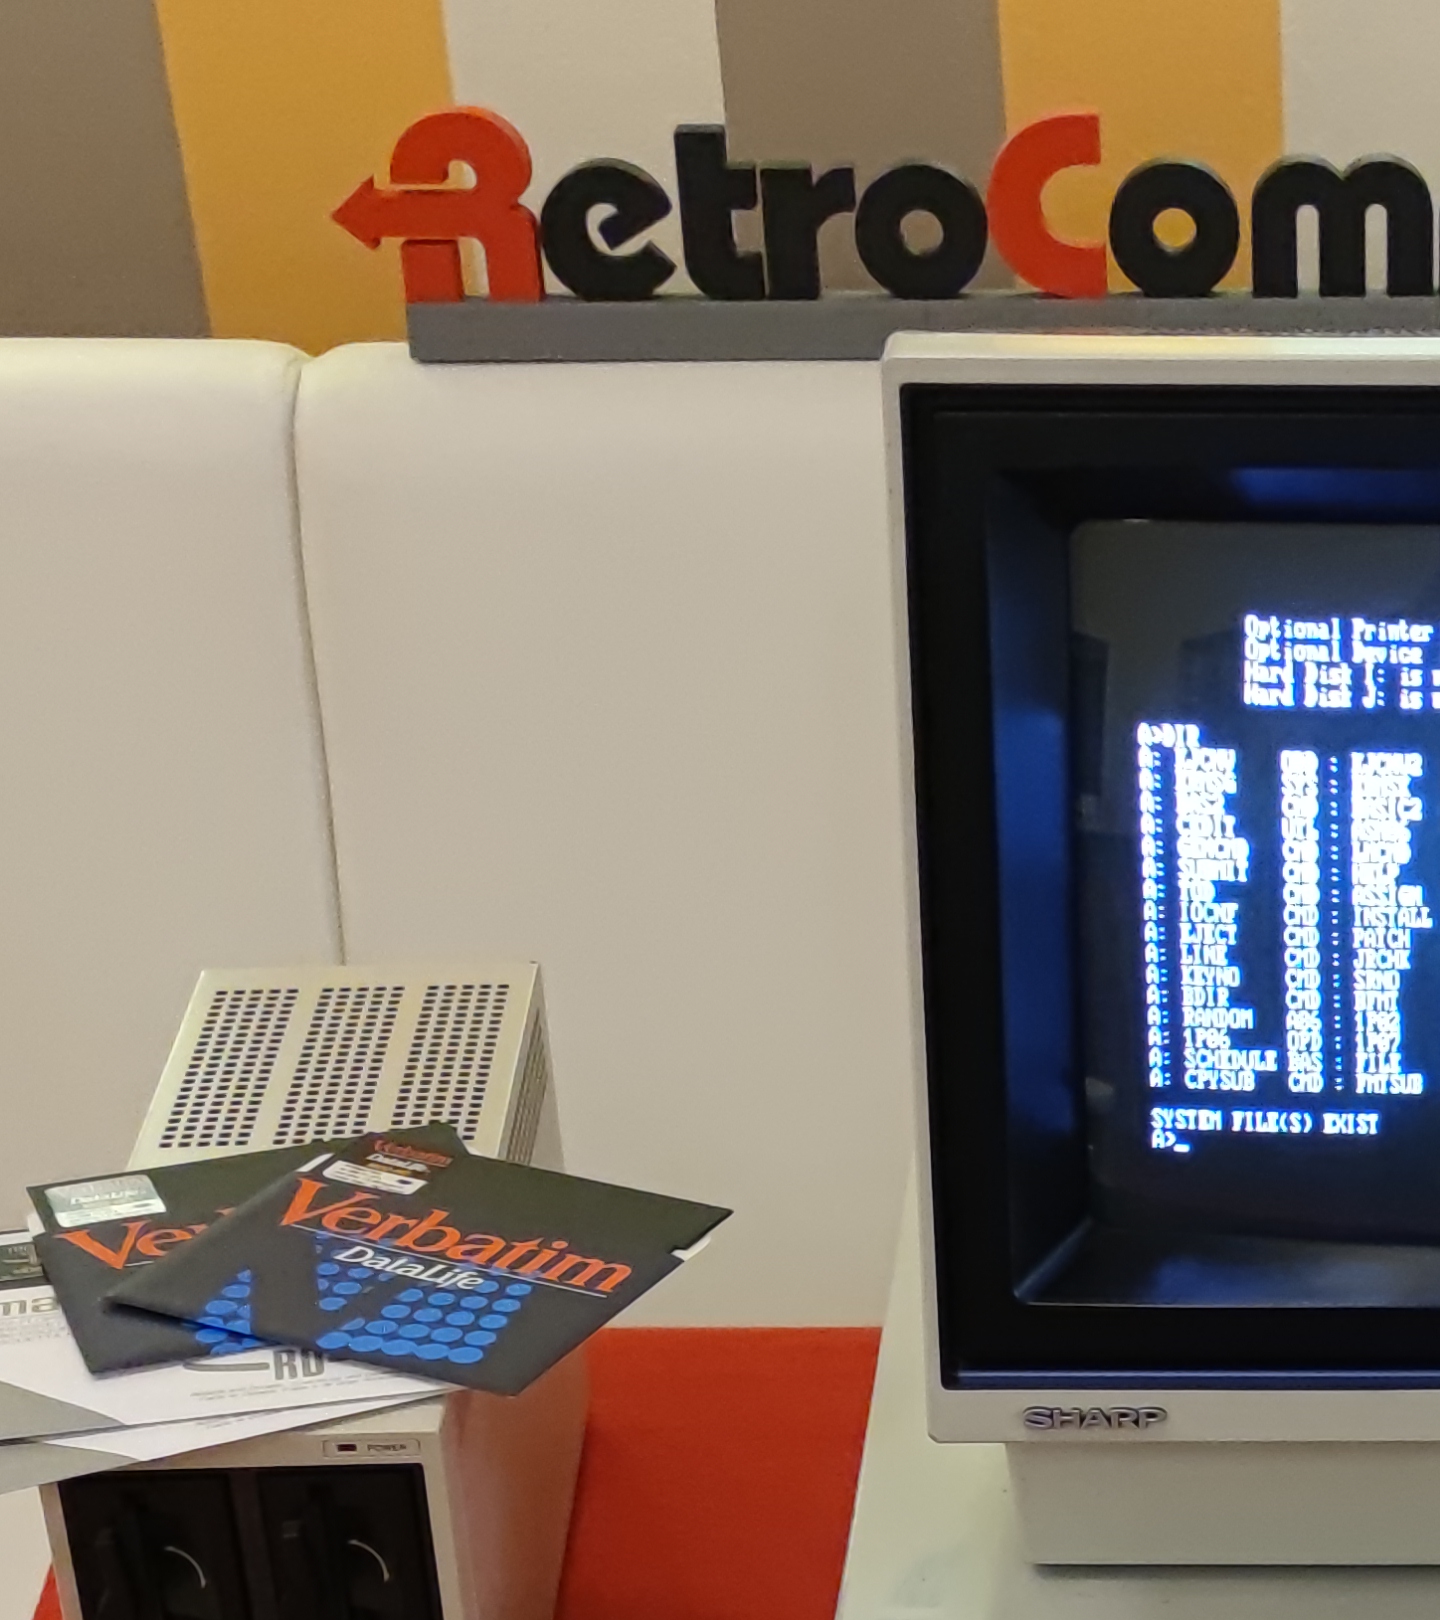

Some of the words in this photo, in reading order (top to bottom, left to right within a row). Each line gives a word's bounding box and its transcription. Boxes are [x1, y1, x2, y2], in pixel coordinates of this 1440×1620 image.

[1245, 615, 1339, 640] Optional
[1352, 619, 1432, 642] Printer
[1245, 639, 1340, 662] Optional
[1352, 641, 1422, 663] Device
[1244, 660, 1293, 683] Hard
[1401, 667, 1422, 686] is
[1244, 684, 1293, 706] Hard
[1401, 690, 1422, 709] is
[1354, 907, 1432, 928] INSTALL
[1183, 1007, 1252, 1028] RANDOM
[1151, 1108, 1221, 1129] SYSTEM
[1232, 1112, 1311, 1133] FILE(S)
[1323, 1113, 1380, 1134] EXIST
[280, 1176, 635, 1295] Verbatim
[334, 1241, 486, 1291] DataLife
[1023, 1405, 1168, 1430] SHARP
